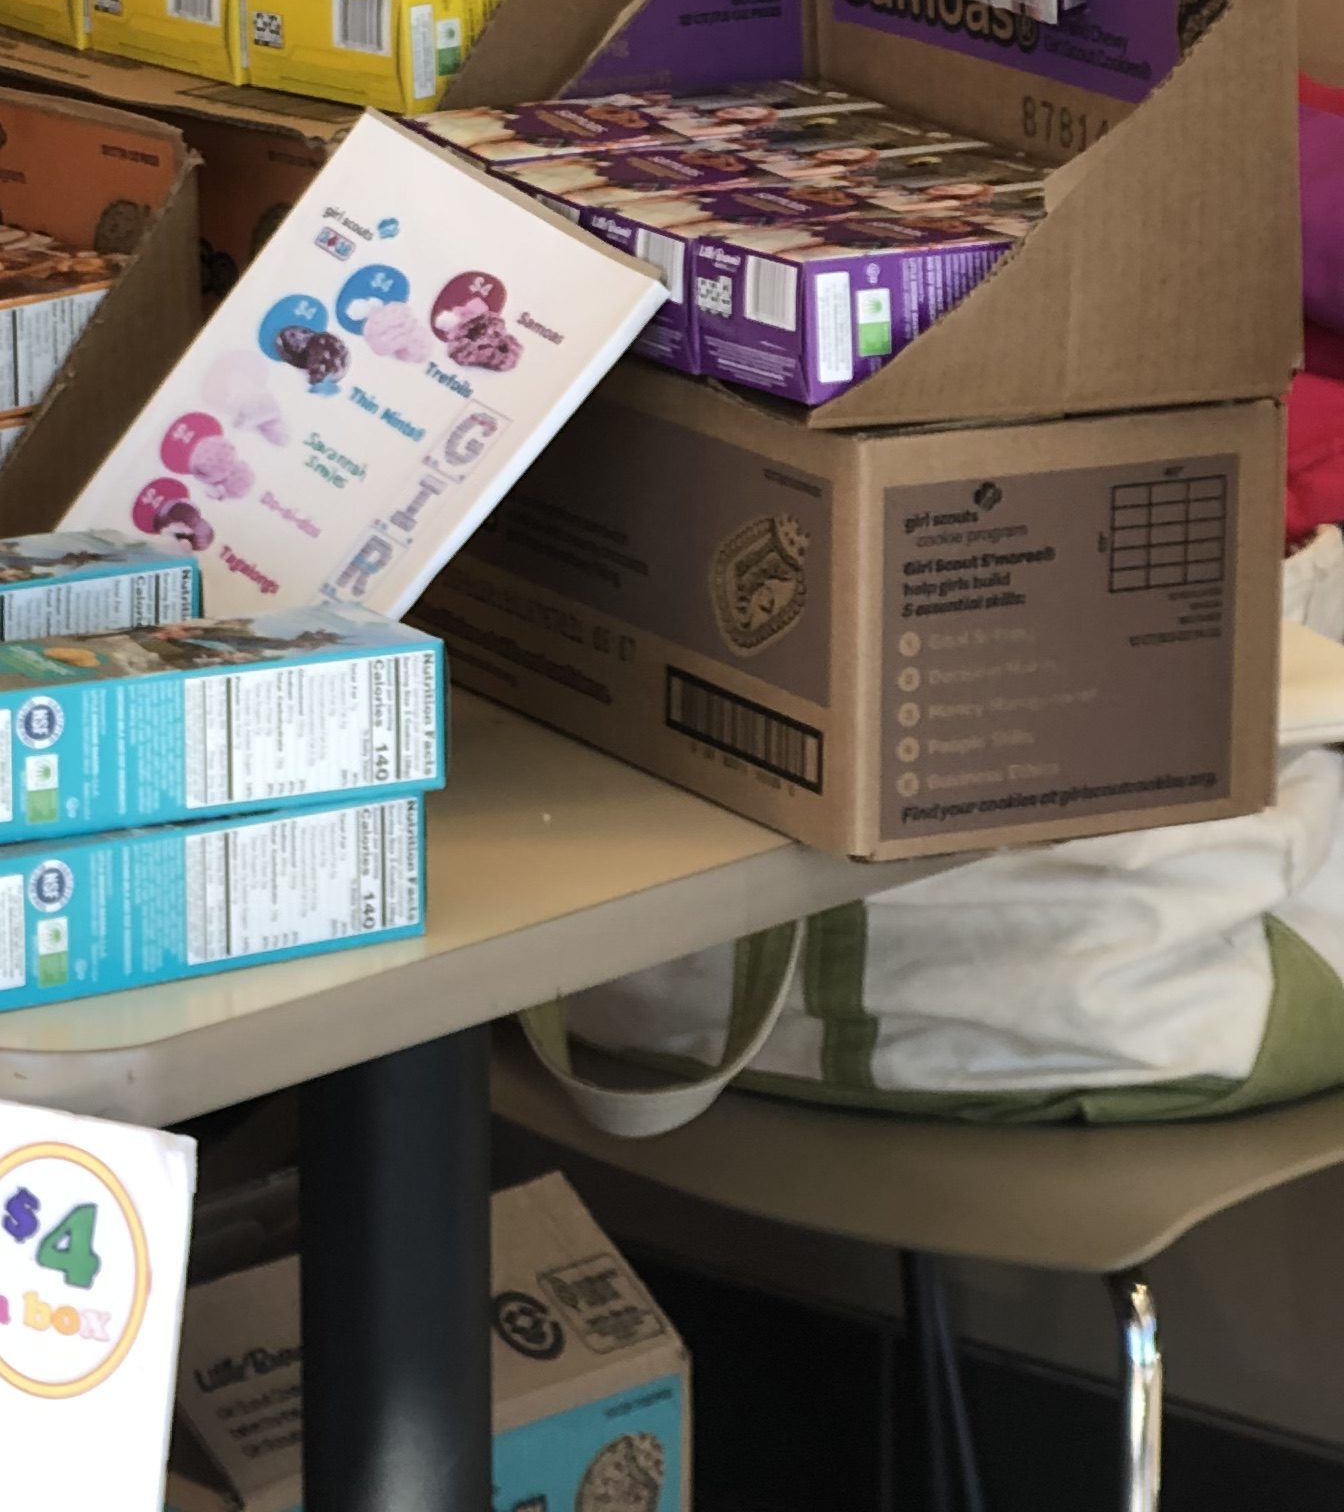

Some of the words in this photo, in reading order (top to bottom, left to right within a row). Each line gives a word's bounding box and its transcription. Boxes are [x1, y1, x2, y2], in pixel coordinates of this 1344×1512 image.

[323, 206, 343, 223] girl
[341, 216, 374, 241] scouts
[371, 272, 395, 293] $4
[469, 276, 494, 297] $4
[294, 300, 317, 321] $4
[517, 311, 565, 345] Samoas
[425, 361, 474, 399] Trefoils
[349, 386, 379, 415] Thin
[302, 432, 369, 483] Savannah
[141, 489, 166, 510] $4
[221, 545, 280, 595] Tagalongs
[373, 659, 385, 728] Calories
[422, 652, 435, 729] Nutrition
[33, 707, 50, 738] NSF
[375, 743, 390, 781] 140
[423, 731, 435, 776] Facts
[361, 808, 371, 877] Calories
[406, 800, 418, 879] Nutrition
[43, 870, 59, 903] NSF
[362, 890, 376, 930] 140
[2, 1186, 103, 1291] $4
[22, 1290, 112, 1343] box
